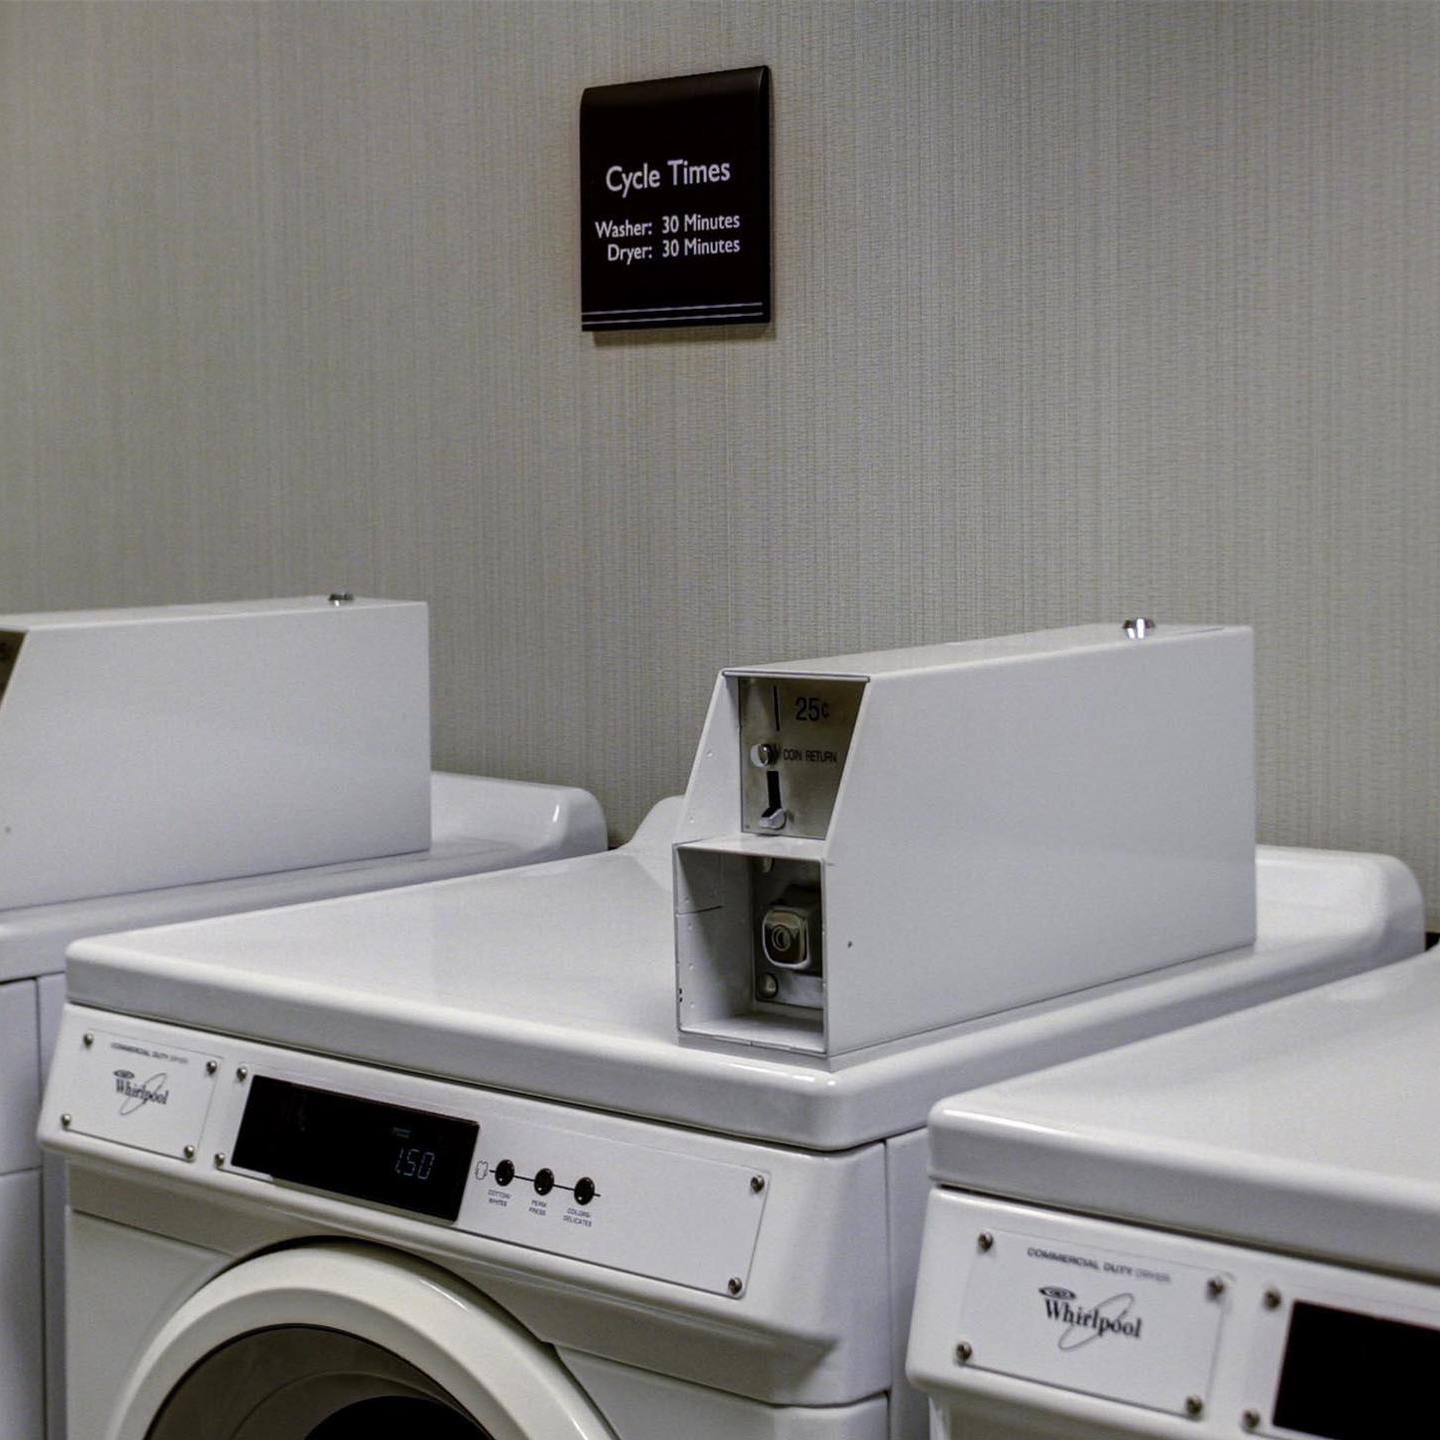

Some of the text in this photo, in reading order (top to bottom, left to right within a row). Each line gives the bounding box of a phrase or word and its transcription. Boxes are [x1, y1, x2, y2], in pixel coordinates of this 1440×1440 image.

[606, 159, 731, 198] Cycle Times
[595, 213, 740, 239] Washer: 30 Minutes
[607, 237, 740, 265] Dryer: 30 Minutes
[783, 748, 838, 762] COIN RETURN
[115, 1078, 169, 1105] Whirlpool
[1026, 1247, 1099, 1271] COMMERCIAL
[1103, 1261, 1133, 1277] DUTY
[1044, 1298, 1143, 1339] Whirlpool
